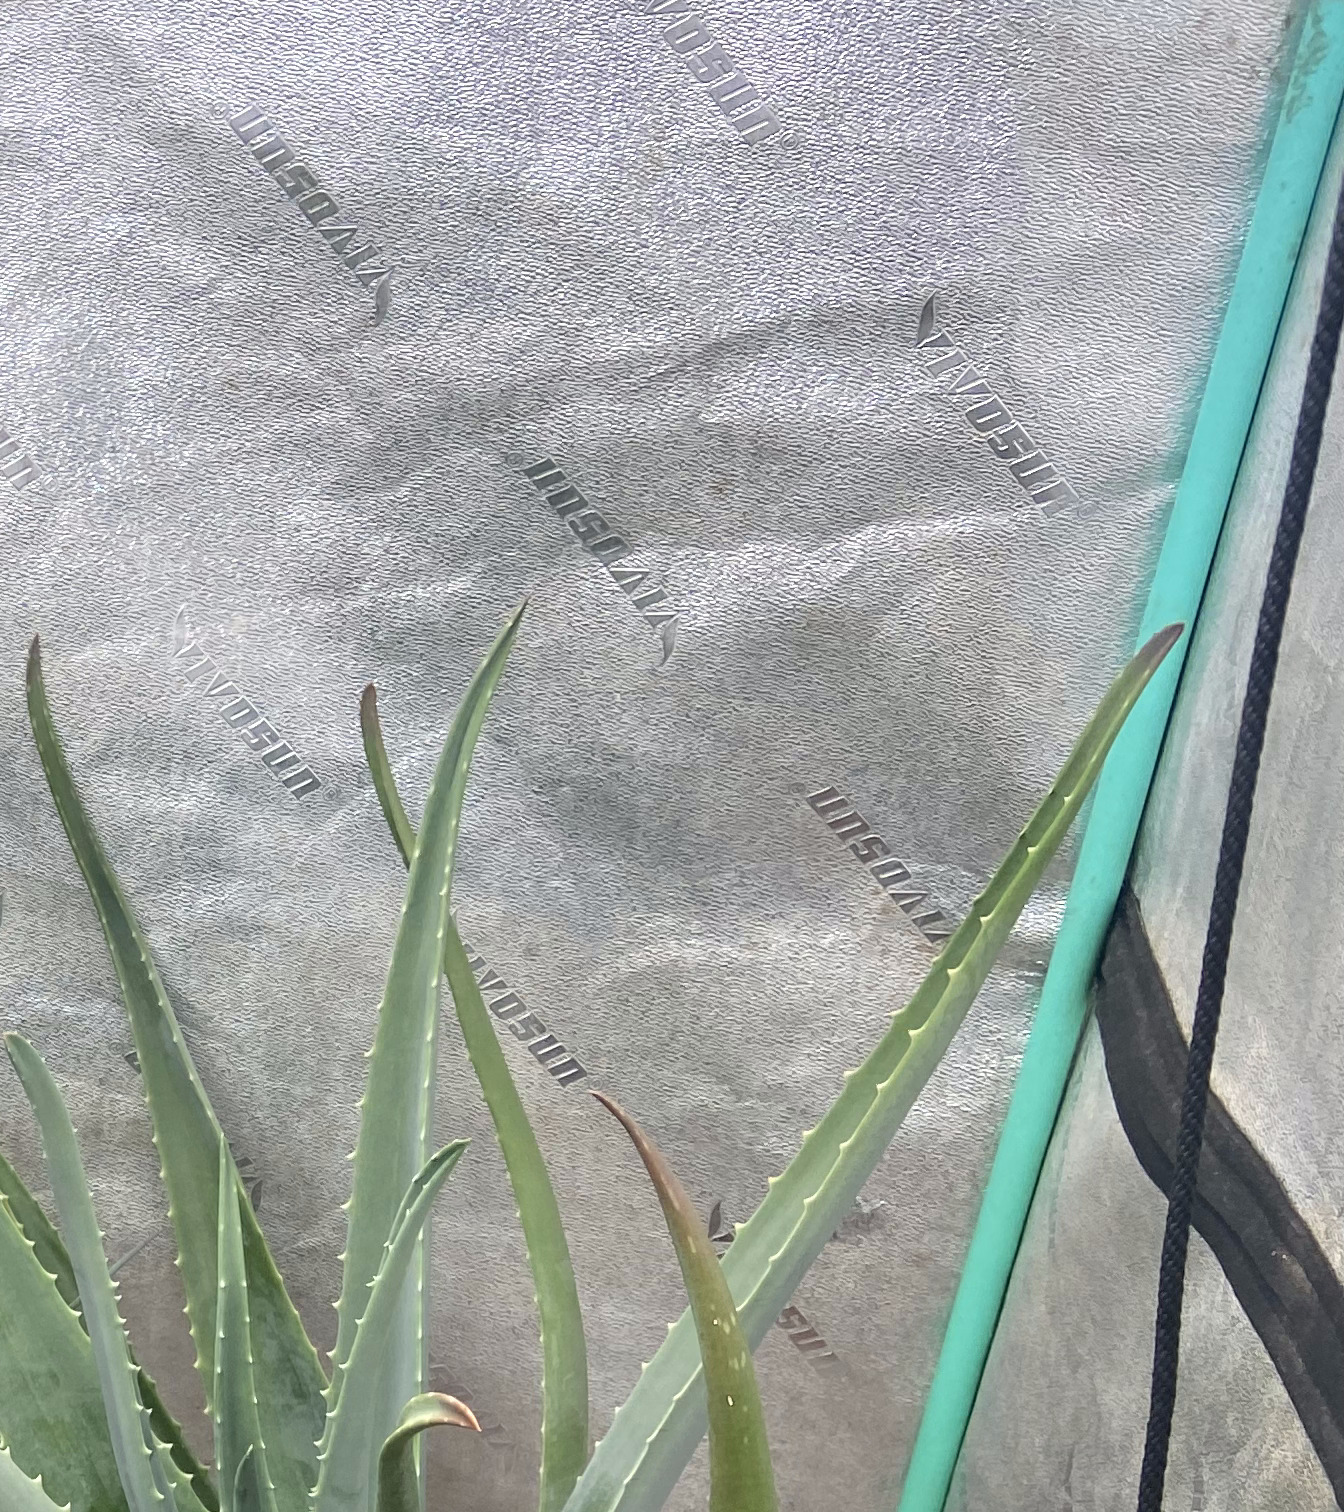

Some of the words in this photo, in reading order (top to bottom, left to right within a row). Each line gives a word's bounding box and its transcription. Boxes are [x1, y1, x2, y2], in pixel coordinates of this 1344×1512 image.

[645, 0, 781, 145] VOSUN
[229, 105, 393, 326] VIVOSUN
[916, 290, 1080, 518] VIVOSUN
[523, 454, 680, 666] VIVOSUN
[174, 603, 321, 800] VIVOSUN
